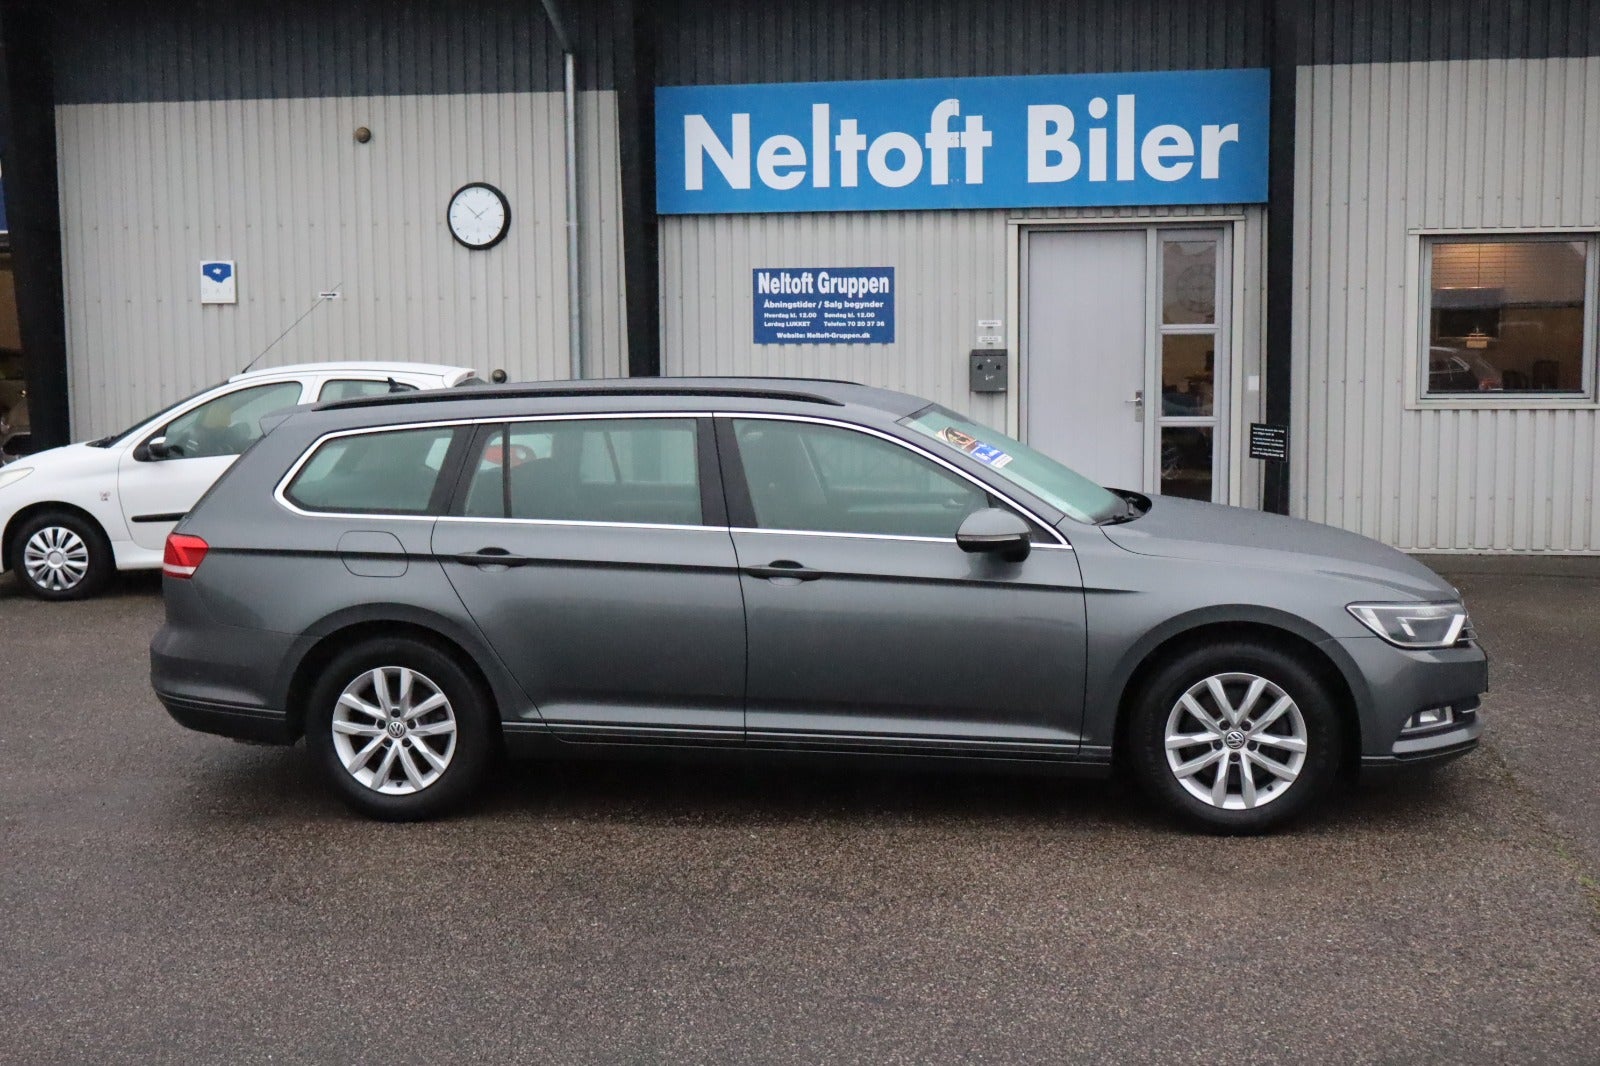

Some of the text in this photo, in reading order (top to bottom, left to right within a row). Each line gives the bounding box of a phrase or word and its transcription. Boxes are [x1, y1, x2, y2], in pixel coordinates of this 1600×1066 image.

[684, 94, 1239, 191] Neltoft Biler
[758, 272, 889, 298] Neltoft Gruppen
[764, 299, 884, 309] Åbningstider / Salg begynder
[806, 332, 871, 340] Neltoft-Gruppen.dk
